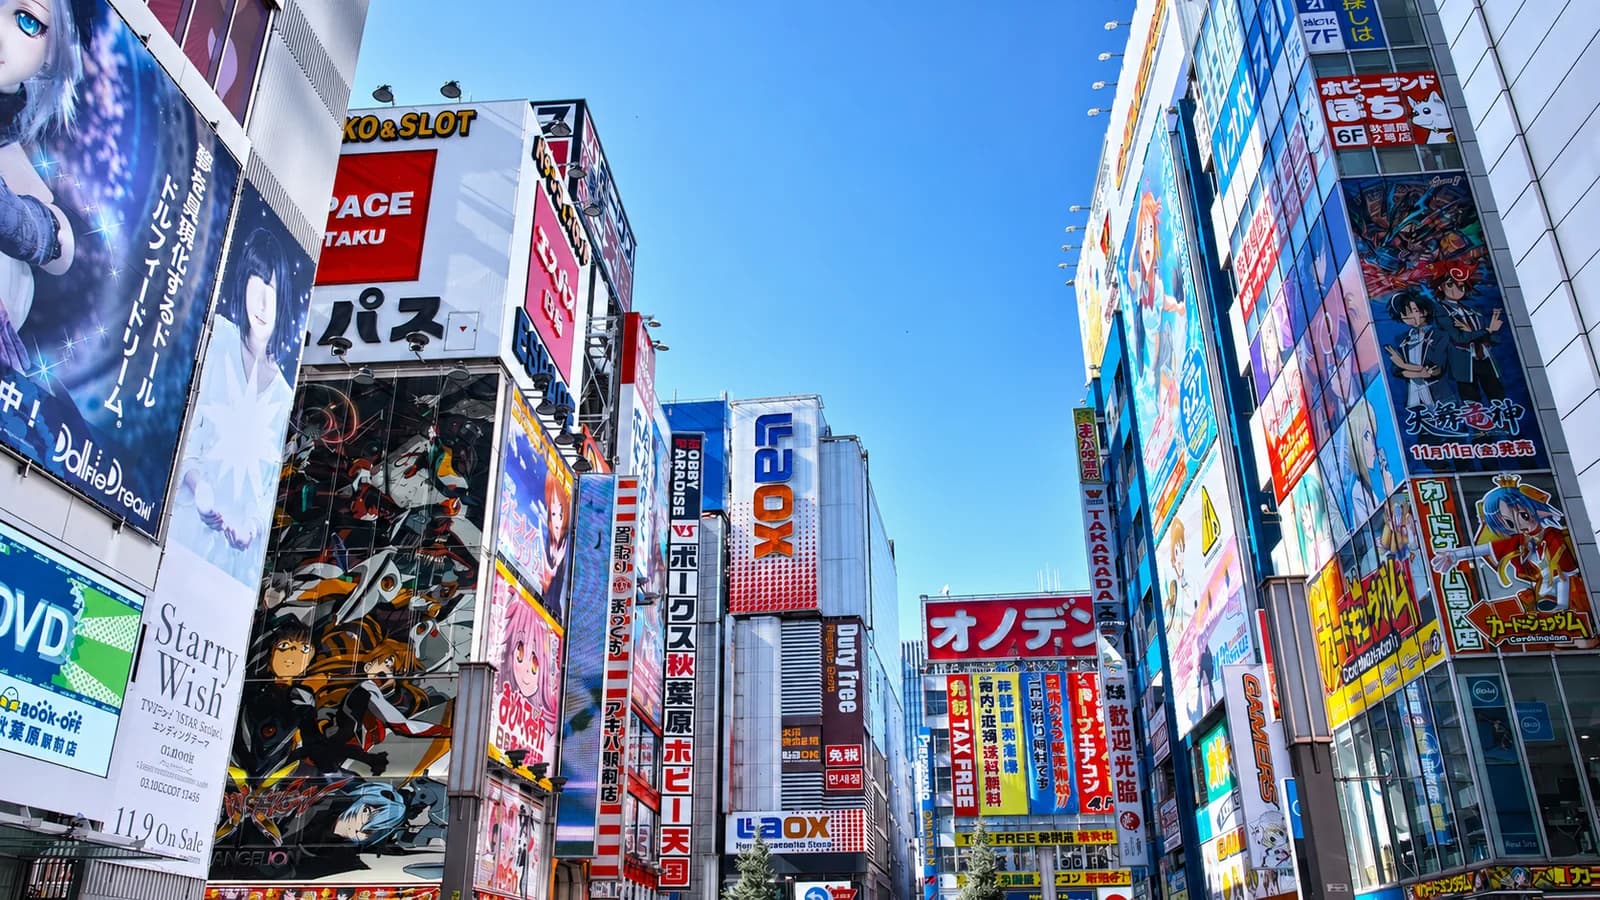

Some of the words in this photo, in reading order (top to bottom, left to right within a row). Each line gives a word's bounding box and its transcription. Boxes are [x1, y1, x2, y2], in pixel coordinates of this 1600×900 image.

[1305, 29, 1338, 45] 7F
[1321, 75, 1435, 96] ホビーランド
[1326, 94, 1405, 122] ぽち
[1337, 129, 1364, 143] 6F
[305, 287, 444, 346] パス
[1087, 509, 1116, 601] TAKARADA
[154, 602, 240, 689] Starry
[930, 598, 1096, 652] オノデン
[156, 649, 225, 720] Wish
[952, 719, 971, 755] TAX
[1108, 703, 1138, 804] 歓迎光臨
[1242, 672, 1280, 811] GAMERS
[954, 758, 975, 808] FREE
[113, 805, 154, 842] 11.9
[155, 822, 176, 848] On
[178, 828, 204, 854] Sale
[996, 832, 1036, 844] FREE
